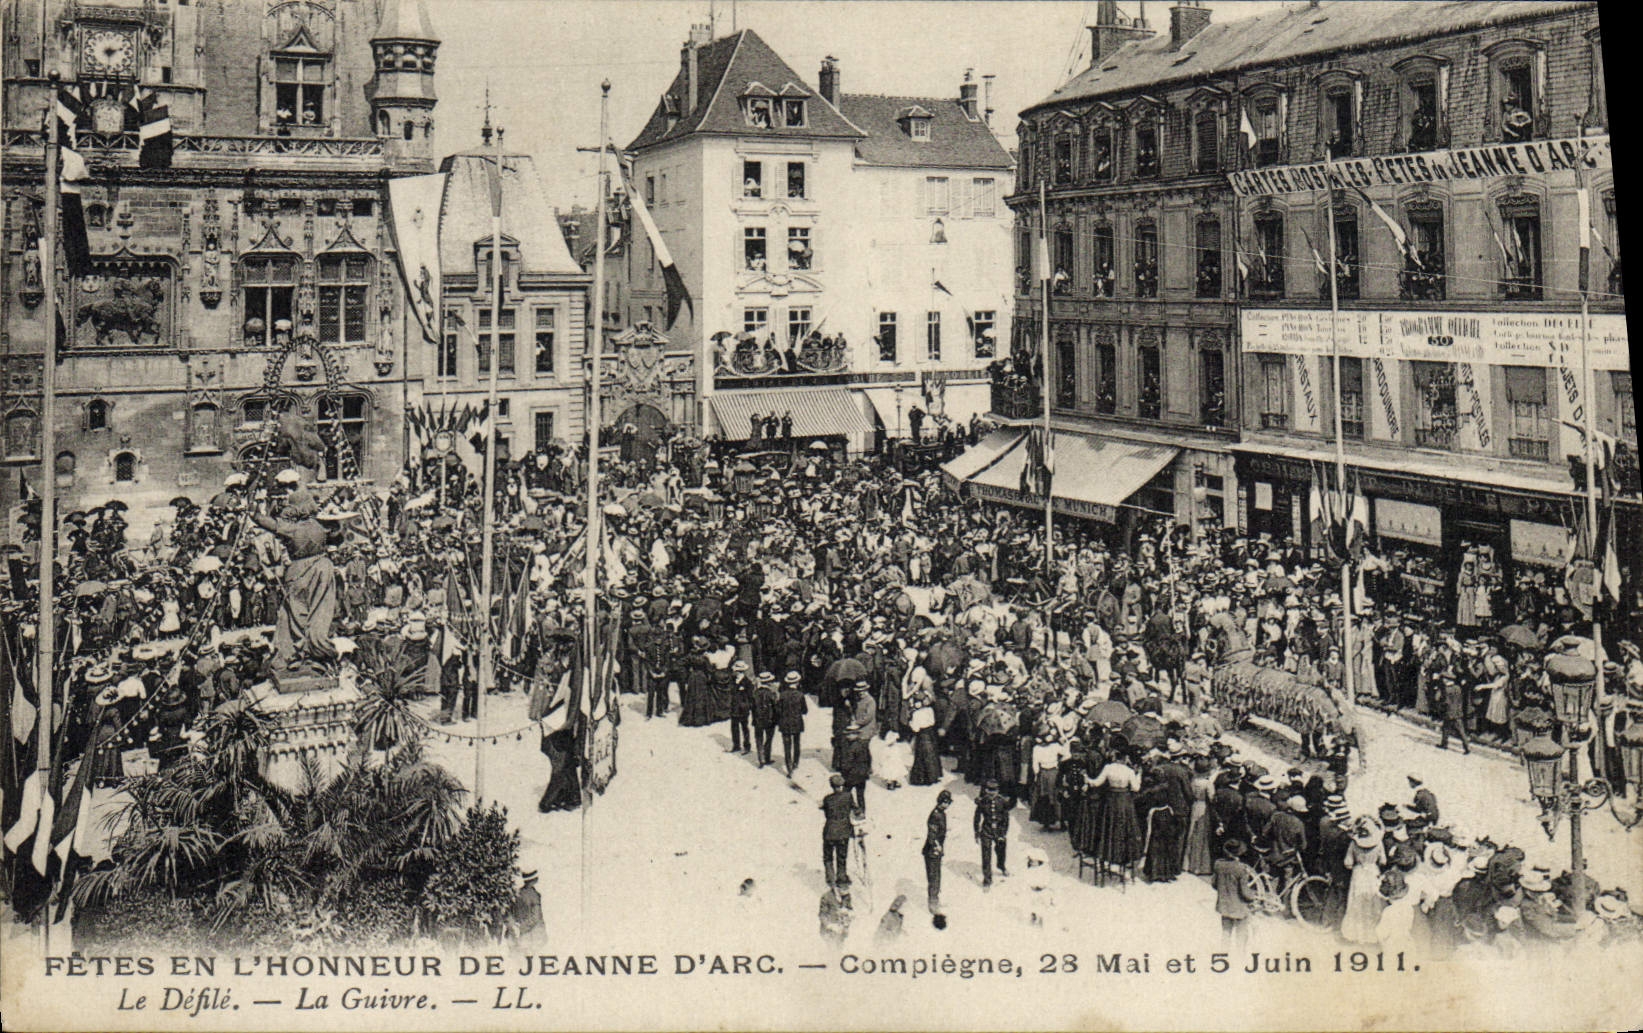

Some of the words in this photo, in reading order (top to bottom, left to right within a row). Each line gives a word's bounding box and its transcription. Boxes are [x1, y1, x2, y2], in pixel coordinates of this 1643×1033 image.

[1233, 170, 1292, 196] CARTES
[1448, 146, 1528, 180] JEANNE
[1430, 335, 1450, 347] 50
